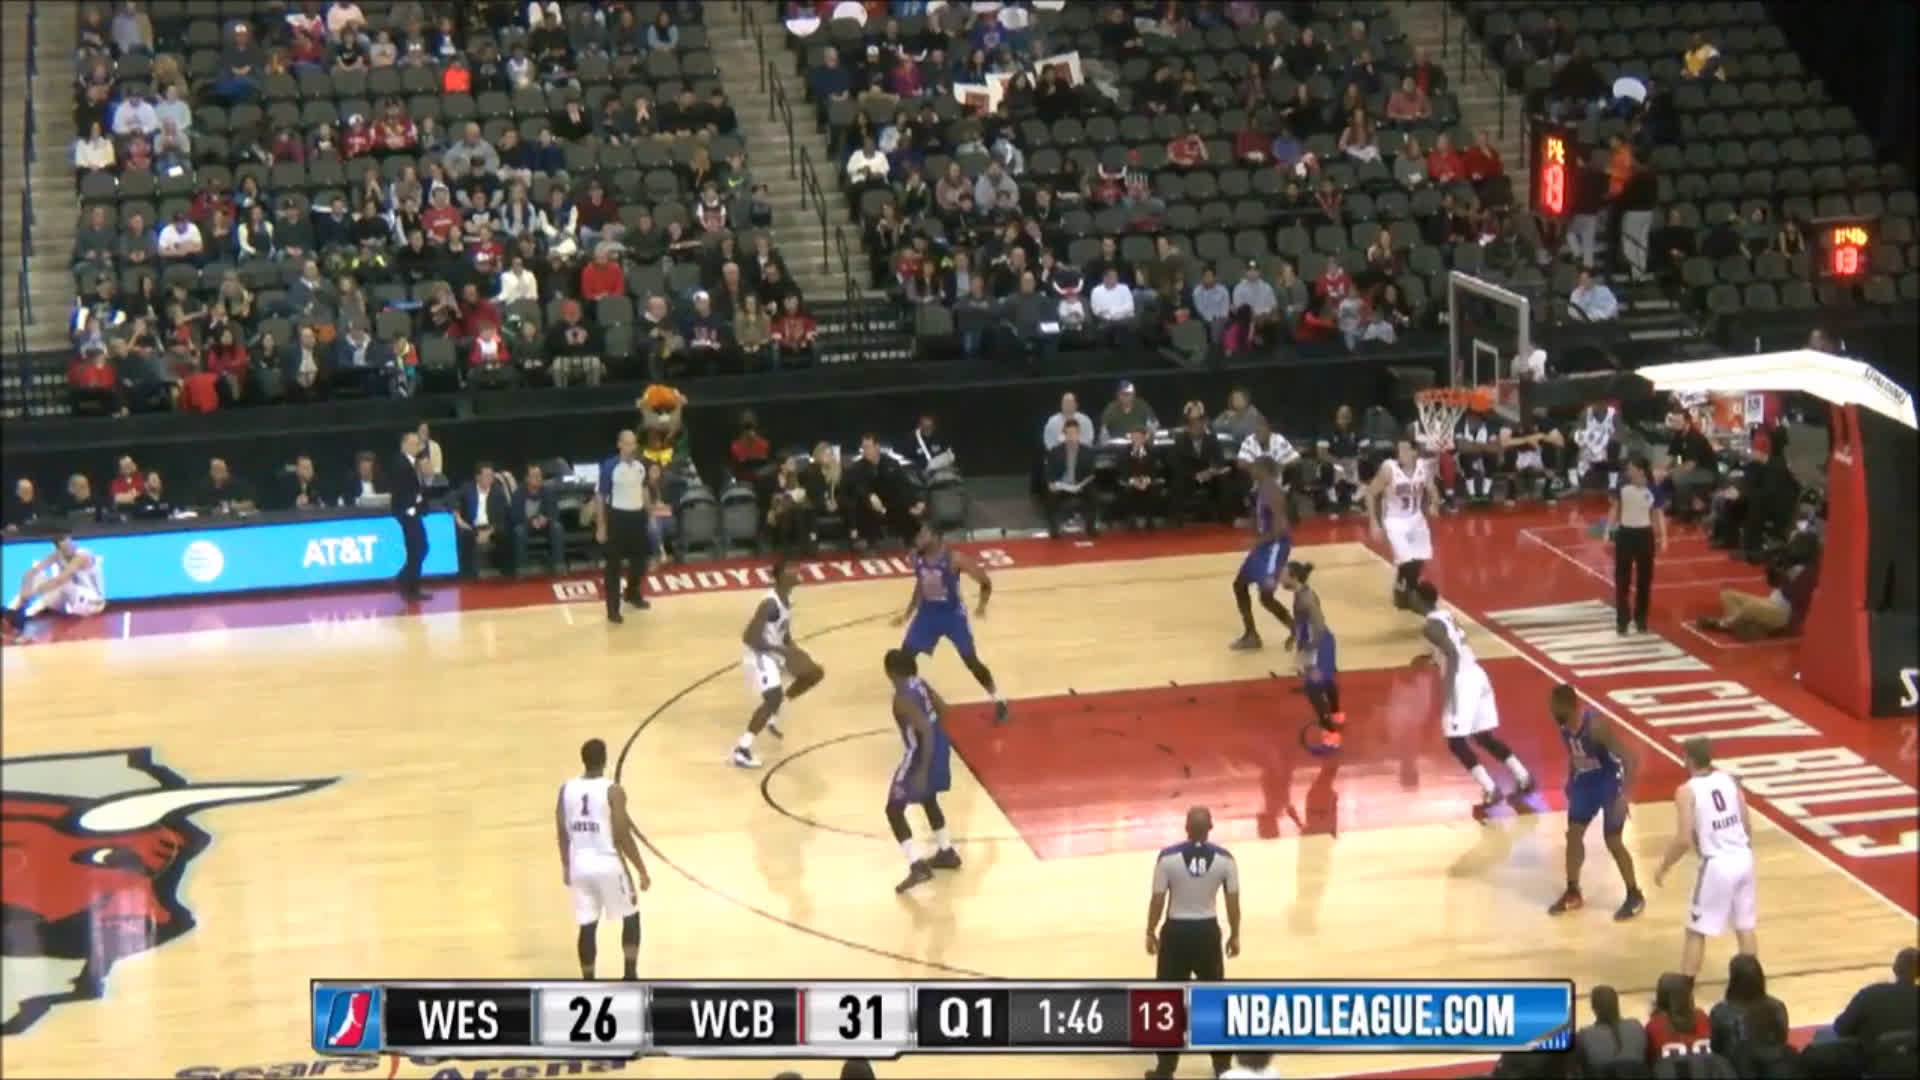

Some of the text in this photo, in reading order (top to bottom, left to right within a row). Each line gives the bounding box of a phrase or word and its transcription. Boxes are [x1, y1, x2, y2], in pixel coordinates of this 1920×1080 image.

[303, 536, 377, 568] AT&T
[1606, 680, 1823, 744] CITY
[580, 793, 590, 816] 1
[1711, 788, 1727, 813] 0
